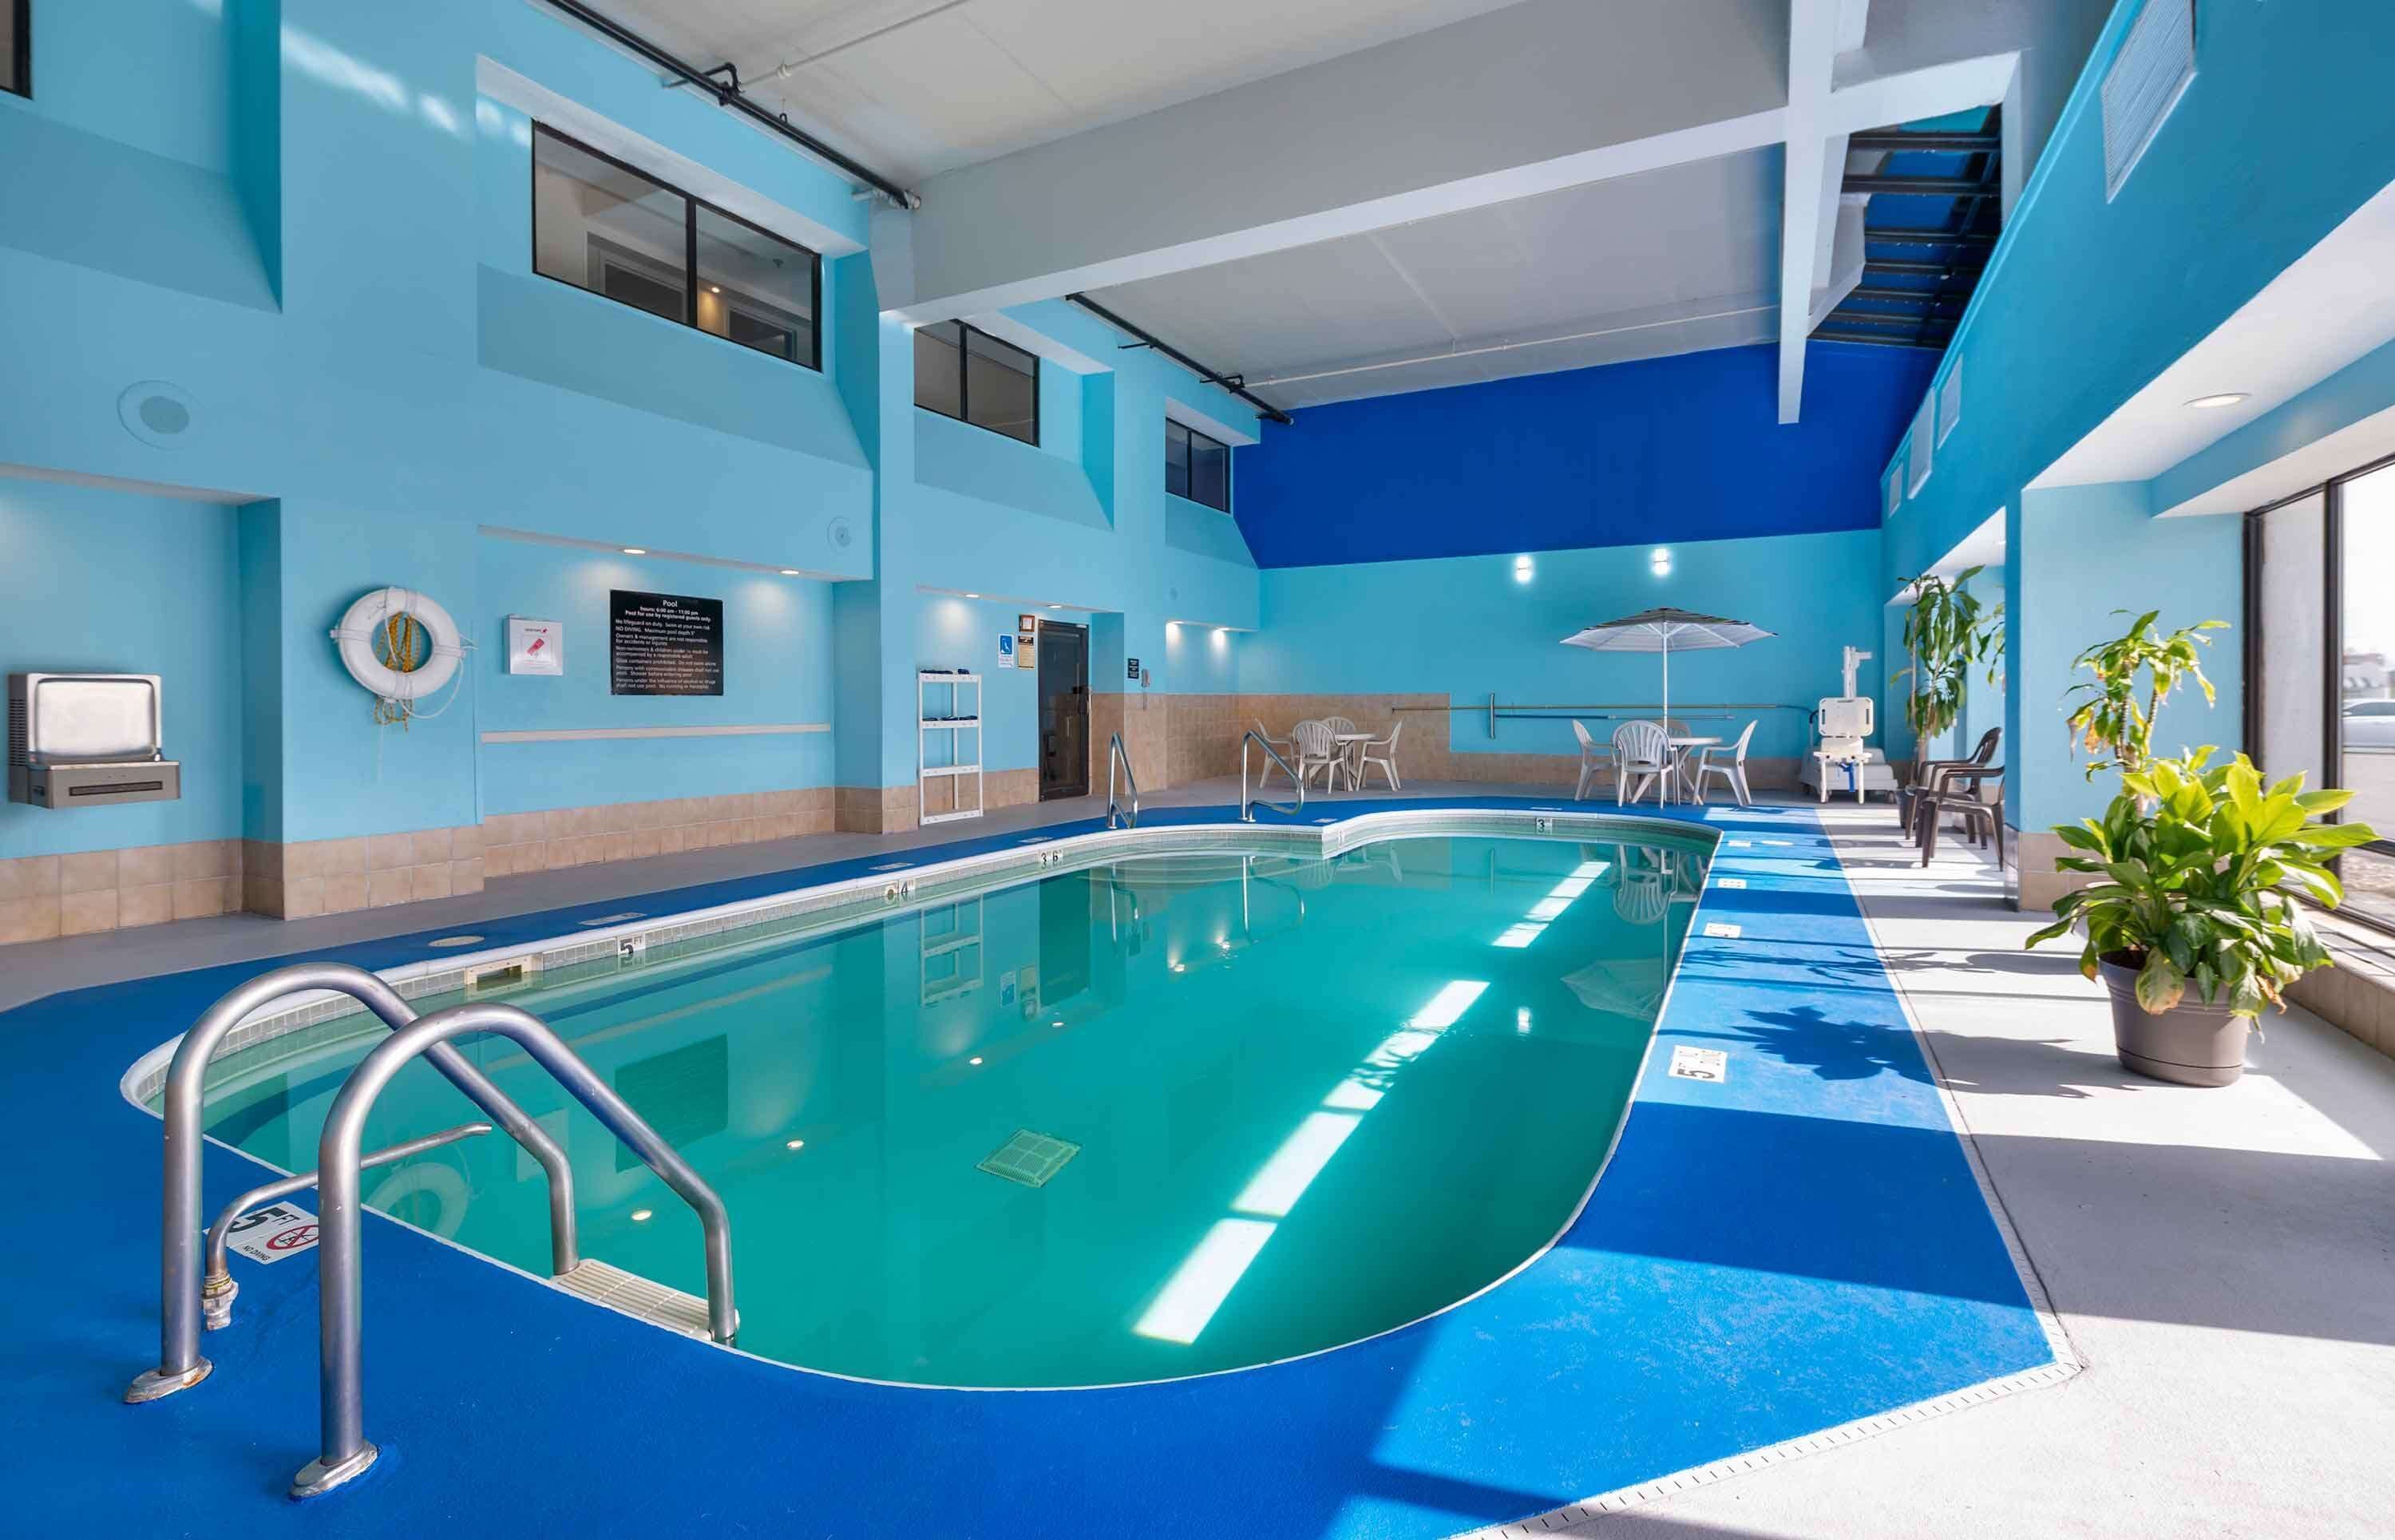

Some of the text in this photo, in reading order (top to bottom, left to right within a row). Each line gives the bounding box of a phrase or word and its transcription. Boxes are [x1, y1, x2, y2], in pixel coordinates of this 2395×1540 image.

[1537, 818, 1546, 828] 3
[1041, 852, 1047, 863] 3
[1052, 849, 1059, 862] 6
[900, 881, 909, 894] 4
[620, 937, 634, 955] 5
[227, 1207, 288, 1233] 5
[250, 1248, 271, 1261] DIVING
